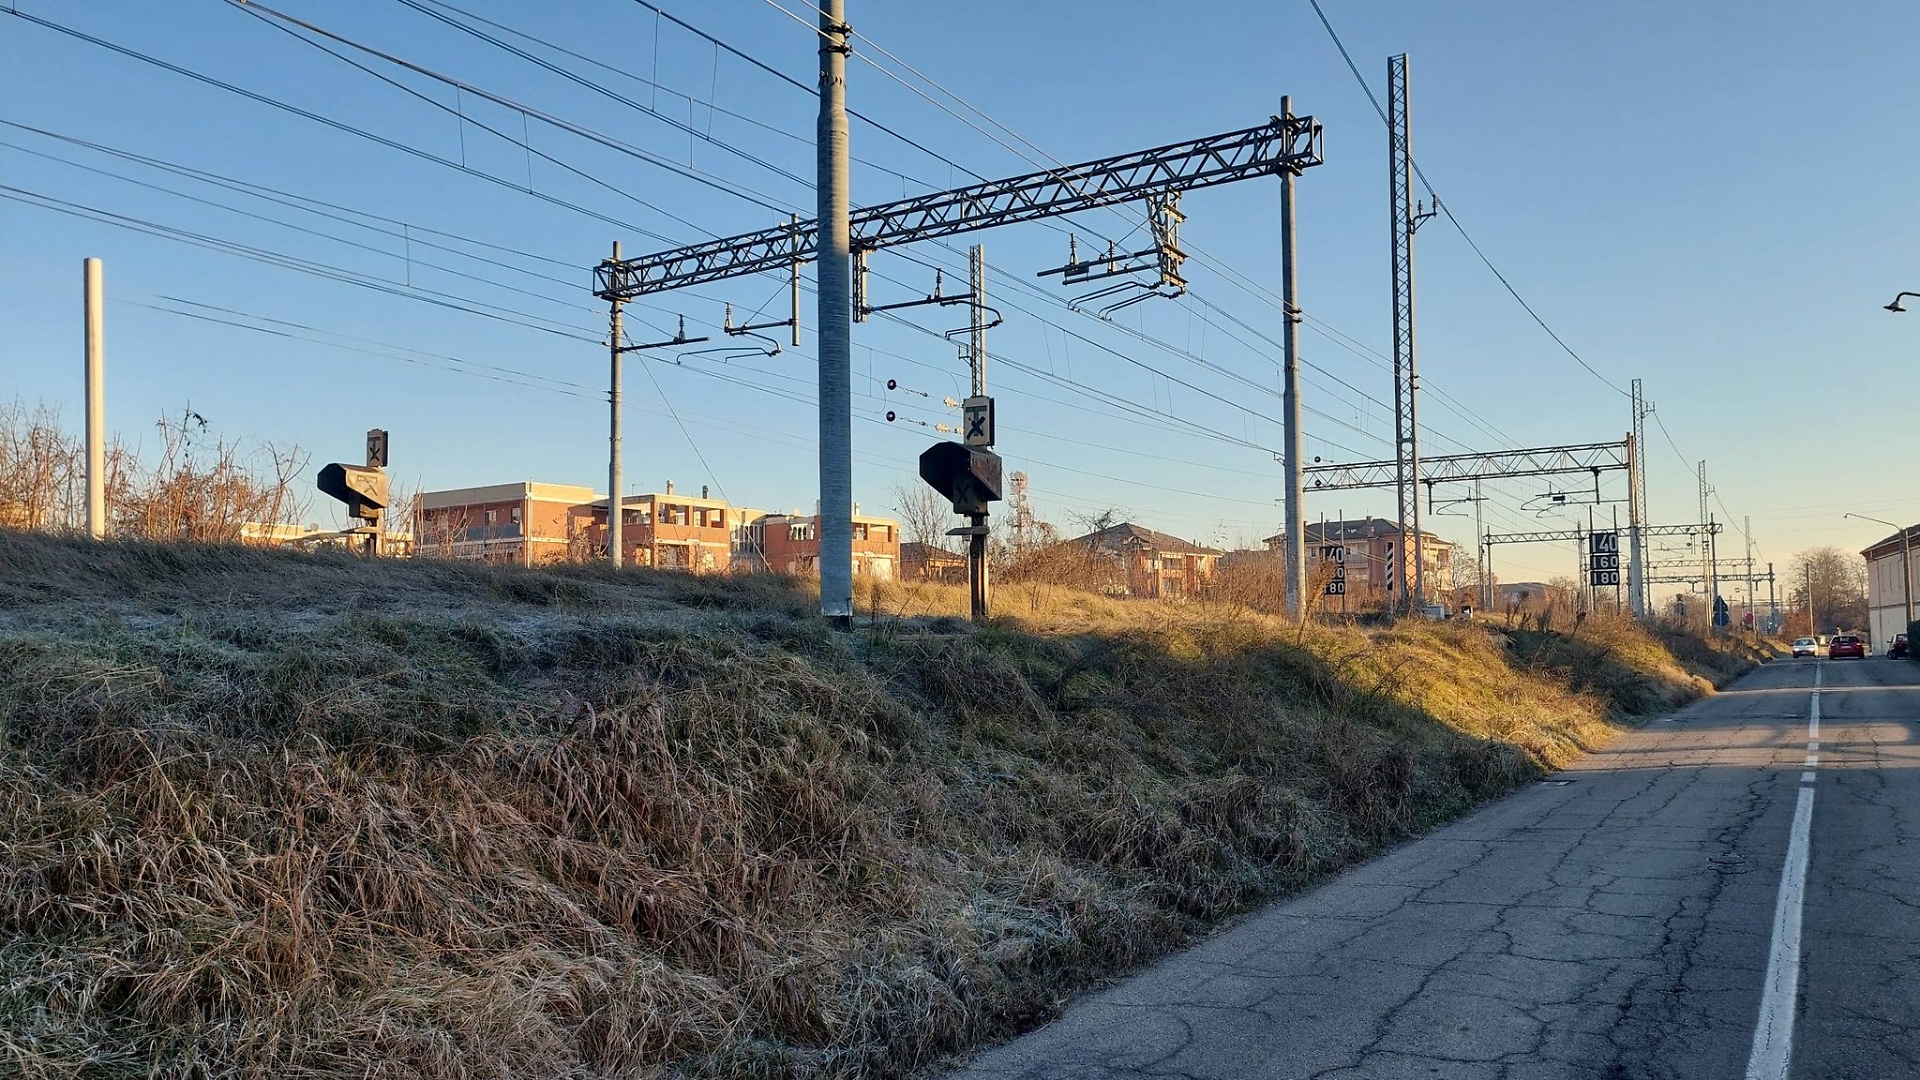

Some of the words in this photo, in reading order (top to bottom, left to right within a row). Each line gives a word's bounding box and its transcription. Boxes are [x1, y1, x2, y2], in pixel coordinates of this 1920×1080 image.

[1592, 534, 1618, 552] 140
[1593, 556, 1618, 568] 160
[1594, 572, 1619, 584] 180
